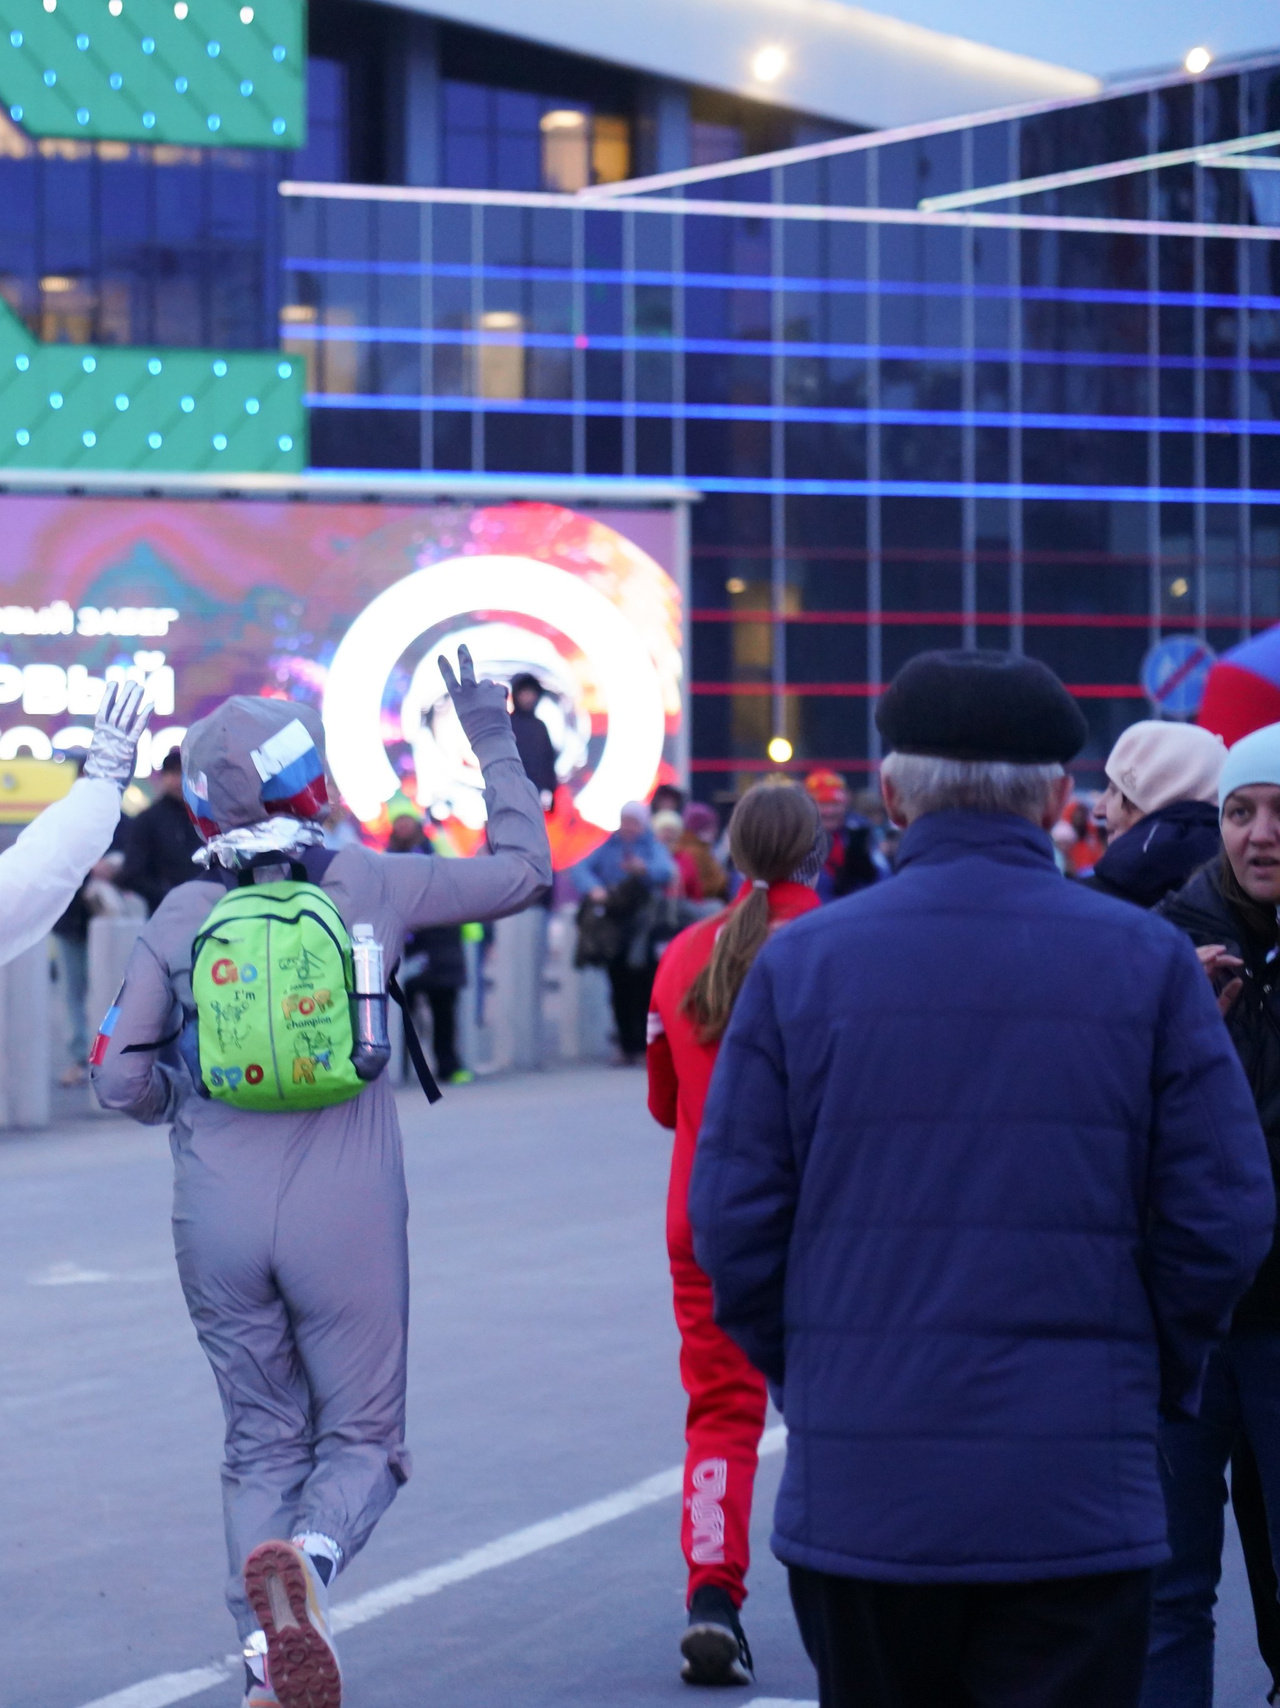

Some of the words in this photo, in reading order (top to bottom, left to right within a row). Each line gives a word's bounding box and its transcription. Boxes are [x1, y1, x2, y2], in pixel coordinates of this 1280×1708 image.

[234, 989, 256, 1001] I'm
[282, 989, 334, 1021] FOR
[285, 1015, 332, 1030] champion
